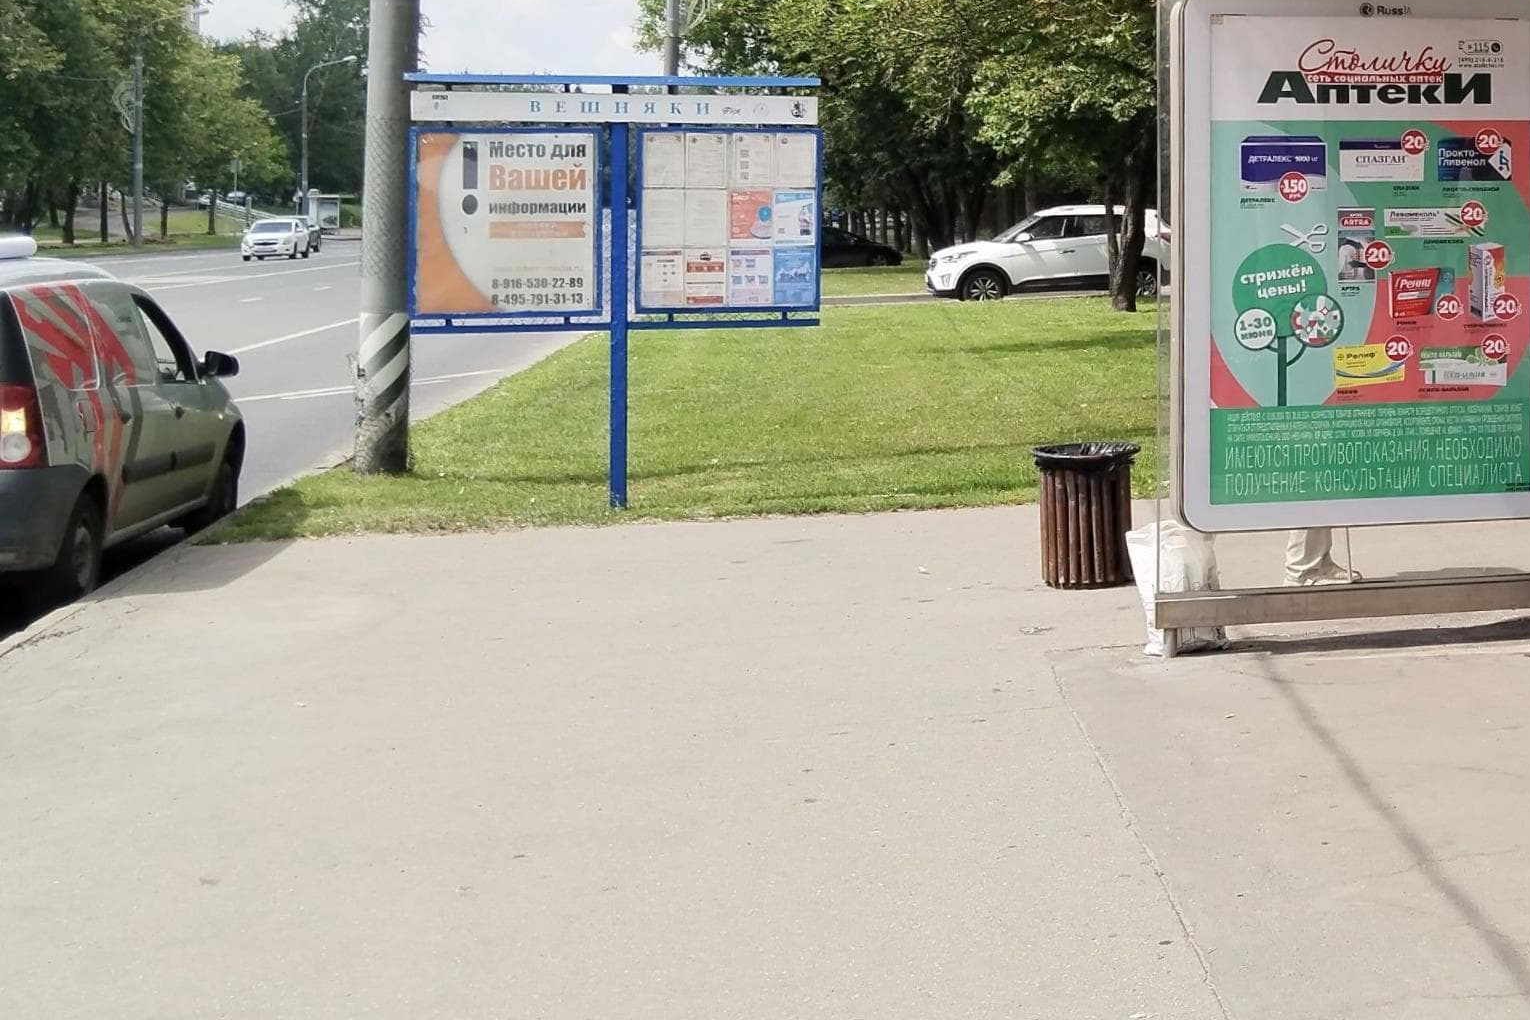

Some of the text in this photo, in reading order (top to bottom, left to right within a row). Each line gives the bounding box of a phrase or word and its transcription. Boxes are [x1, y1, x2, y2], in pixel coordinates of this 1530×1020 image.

[1297, 38, 1452, 73] Столички
[1307, 73, 1443, 83] сеть социальных аптек
[530, 100, 710, 116] ВЕШНЯКИ
[489, 141, 586, 160] Место для
[1438, 148, 1480, 158] Прокто-
[1355, 155, 1405, 164] СПАЗГАН
[1438, 158, 1486, 167] Гливенол
[489, 163, 586, 190] Вашей
[489, 202, 586, 215] информации
[1240, 264, 1314, 286] стрижём
[1257, 279, 1306, 299] цены!
[491, 293, 583, 305] 8-495-791-31-13
[1239, 316, 1273, 331] 1-30
[1225, 436, 1522, 470] ИМЕЮТСЯ ПРОТИВОПОКАЗАНИЯ. НЕОБХОДИМО
[1225, 462, 1523, 496] ПОЛУЧЕНИЕ КОНСУЛЬТАЦИИ СПЕЦИАЛИСТА
